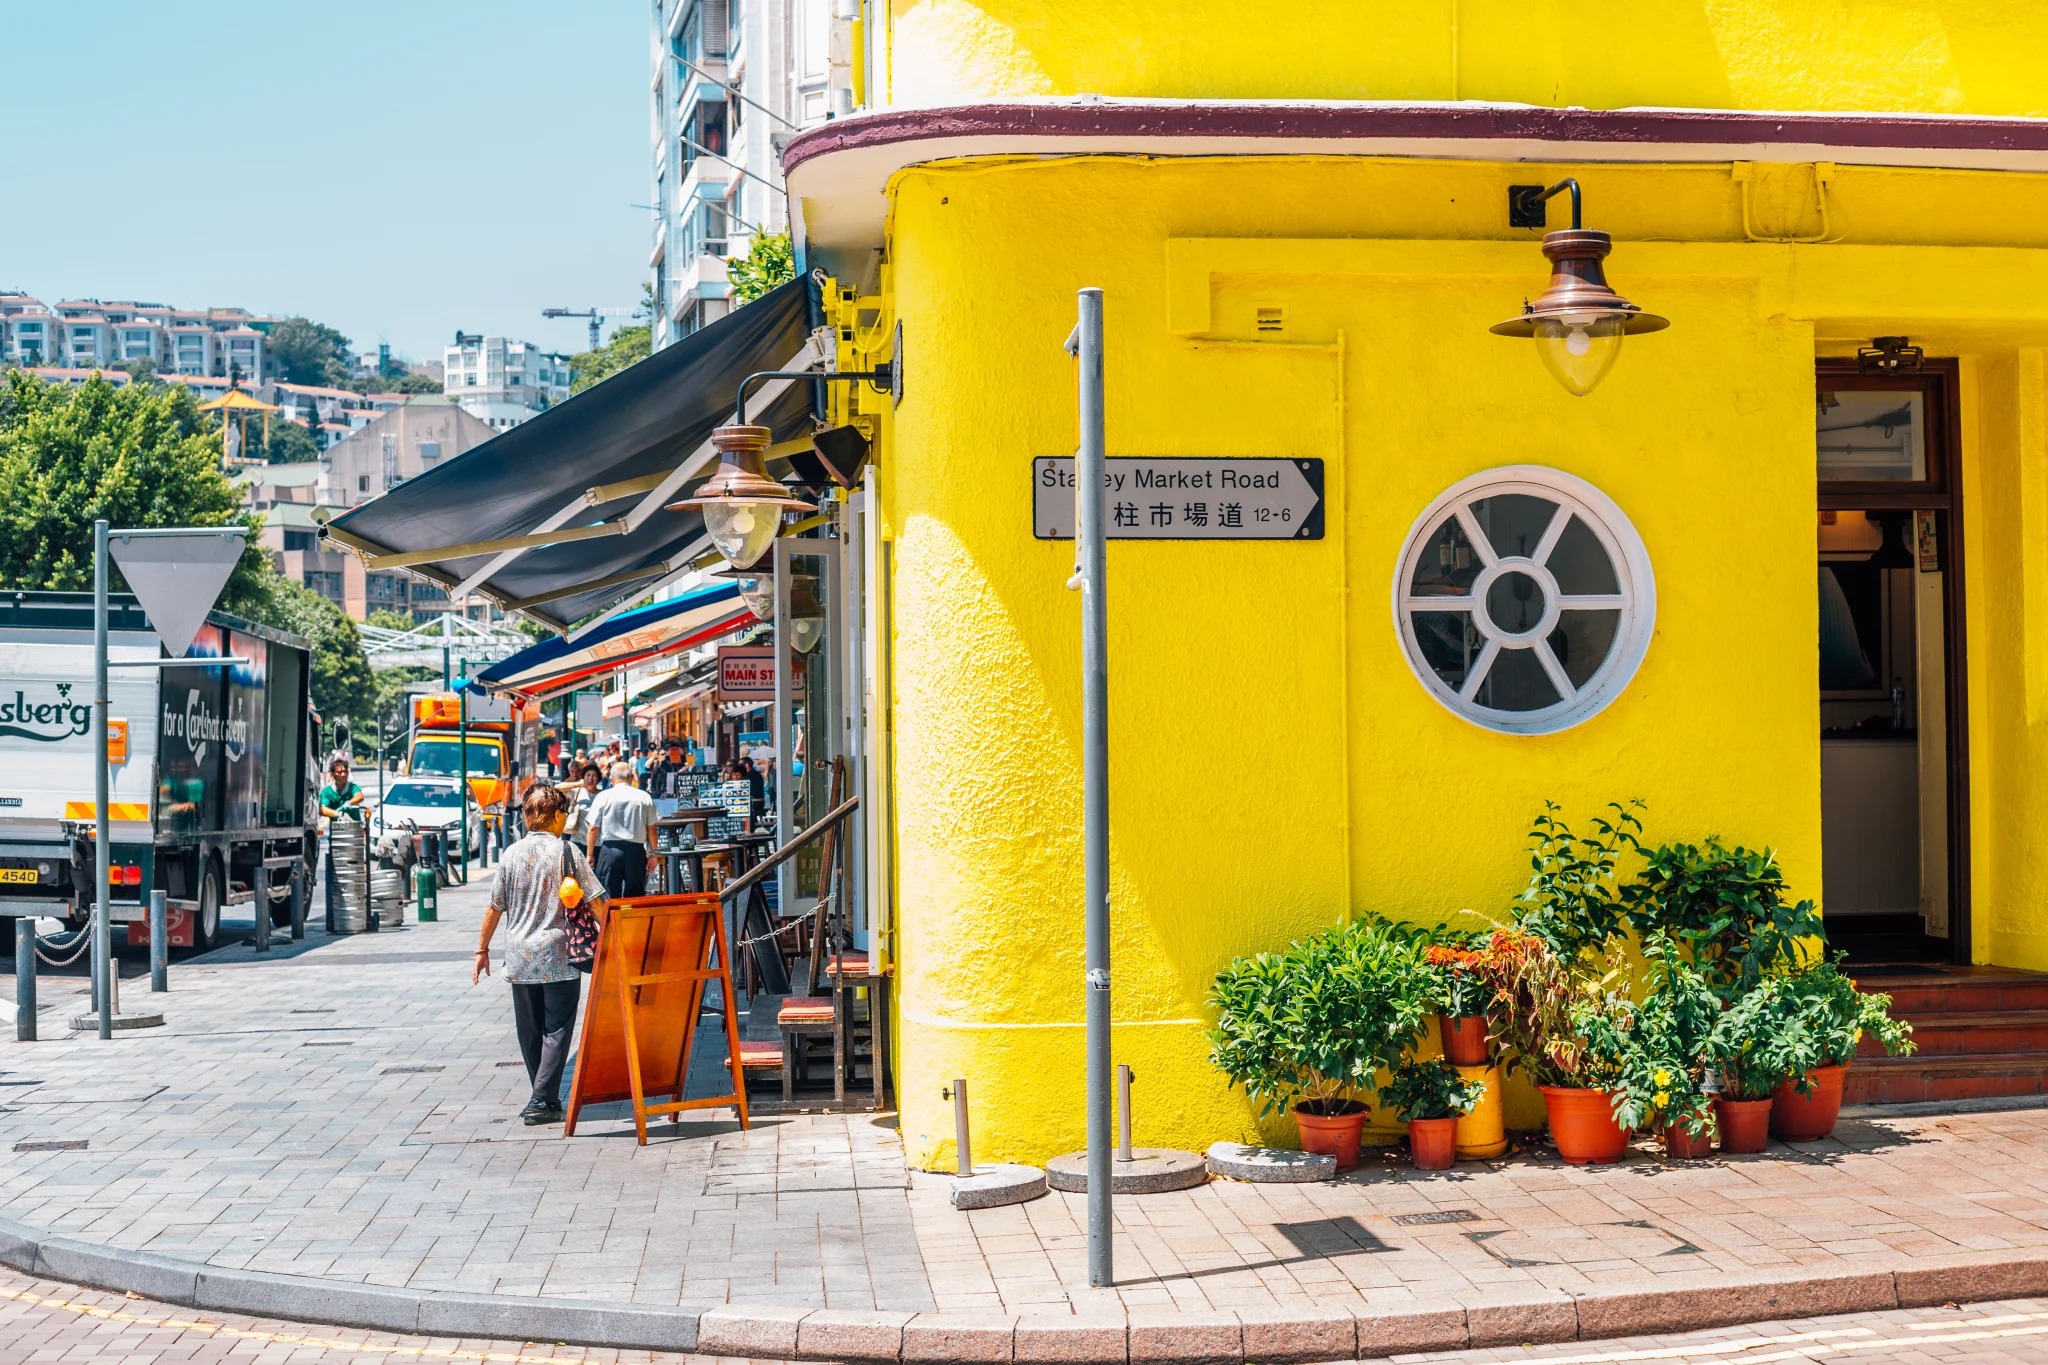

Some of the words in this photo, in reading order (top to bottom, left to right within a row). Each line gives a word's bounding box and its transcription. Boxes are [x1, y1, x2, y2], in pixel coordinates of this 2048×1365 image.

[1042, 469, 1126, 491] Staey
[1135, 469, 1213, 488] Market
[1221, 470, 1279, 488] Road
[1114, 502, 1243, 527] 柱市場道
[725, 670, 756, 680] MAIN
[164, 703, 177, 736] for
[178, 714, 183, 737] a
[2, 872, 35, 882] 4540
[138, 936, 184, 944] HO
